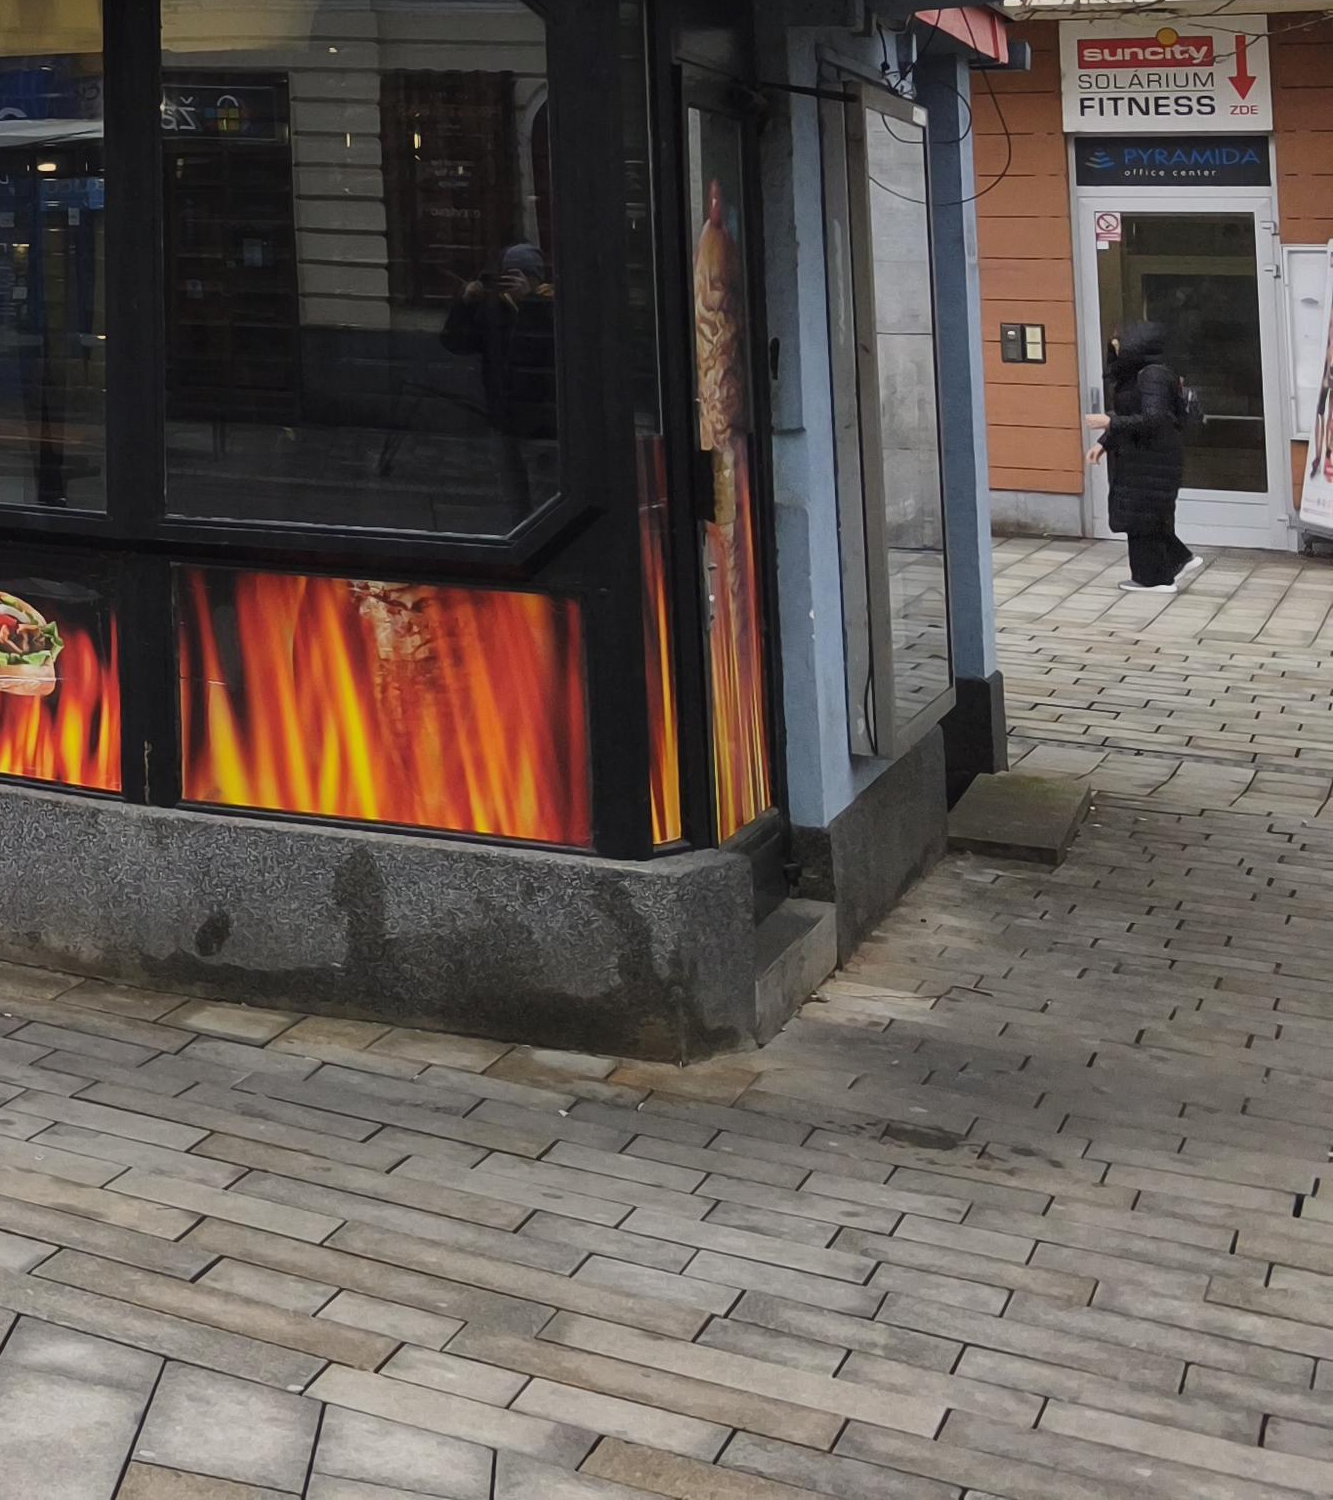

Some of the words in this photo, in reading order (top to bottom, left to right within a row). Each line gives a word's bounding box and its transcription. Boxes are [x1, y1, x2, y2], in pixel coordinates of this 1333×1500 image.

[1082, 43, 1209, 64] suncity
[1077, 69, 1215, 90] SOLÁRIUM
[1079, 95, 1216, 117] FITNESS
[1229, 104, 1259, 116] ZDE
[1124, 148, 1260, 166] PYRAMIDA
[1124, 167, 1167, 177] office
[1172, 168, 1217, 177] center
